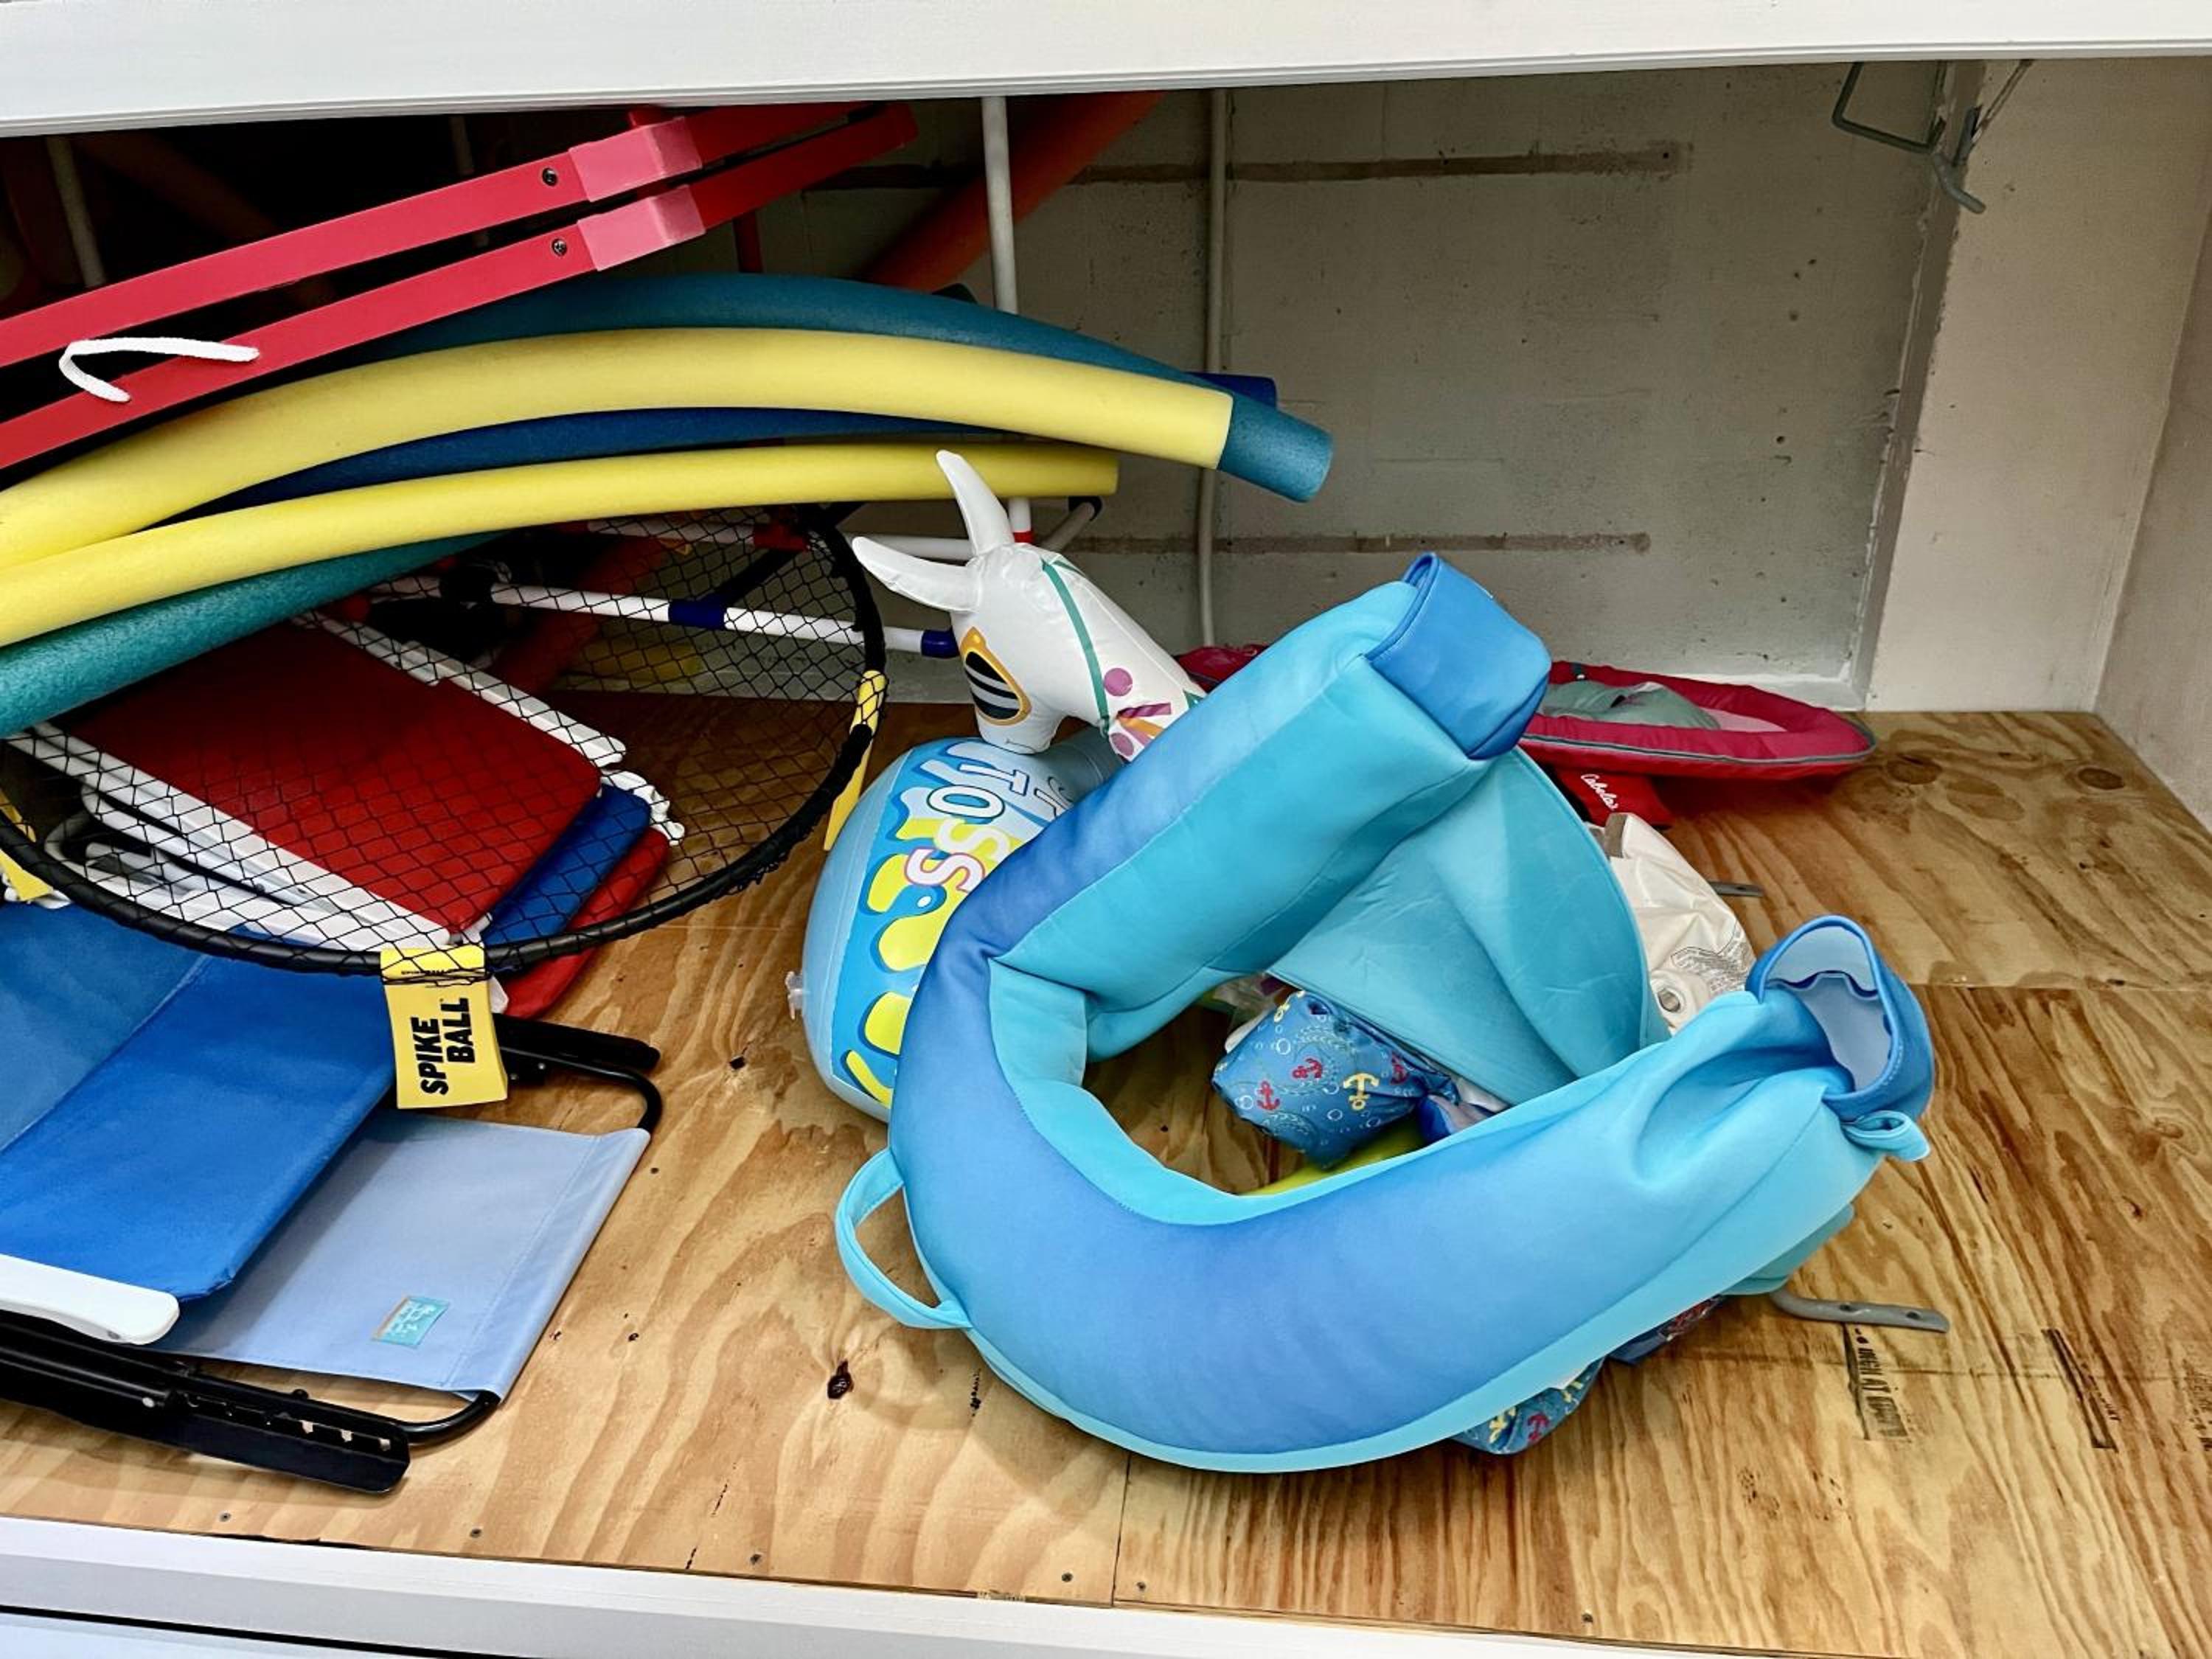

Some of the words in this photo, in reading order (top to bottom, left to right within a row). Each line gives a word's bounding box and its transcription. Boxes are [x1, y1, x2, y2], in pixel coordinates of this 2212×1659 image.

[904, 762, 1029, 893] TOSS
[410, 1017, 449, 1095] SPIKE
[440, 998, 476, 1063] BALL
